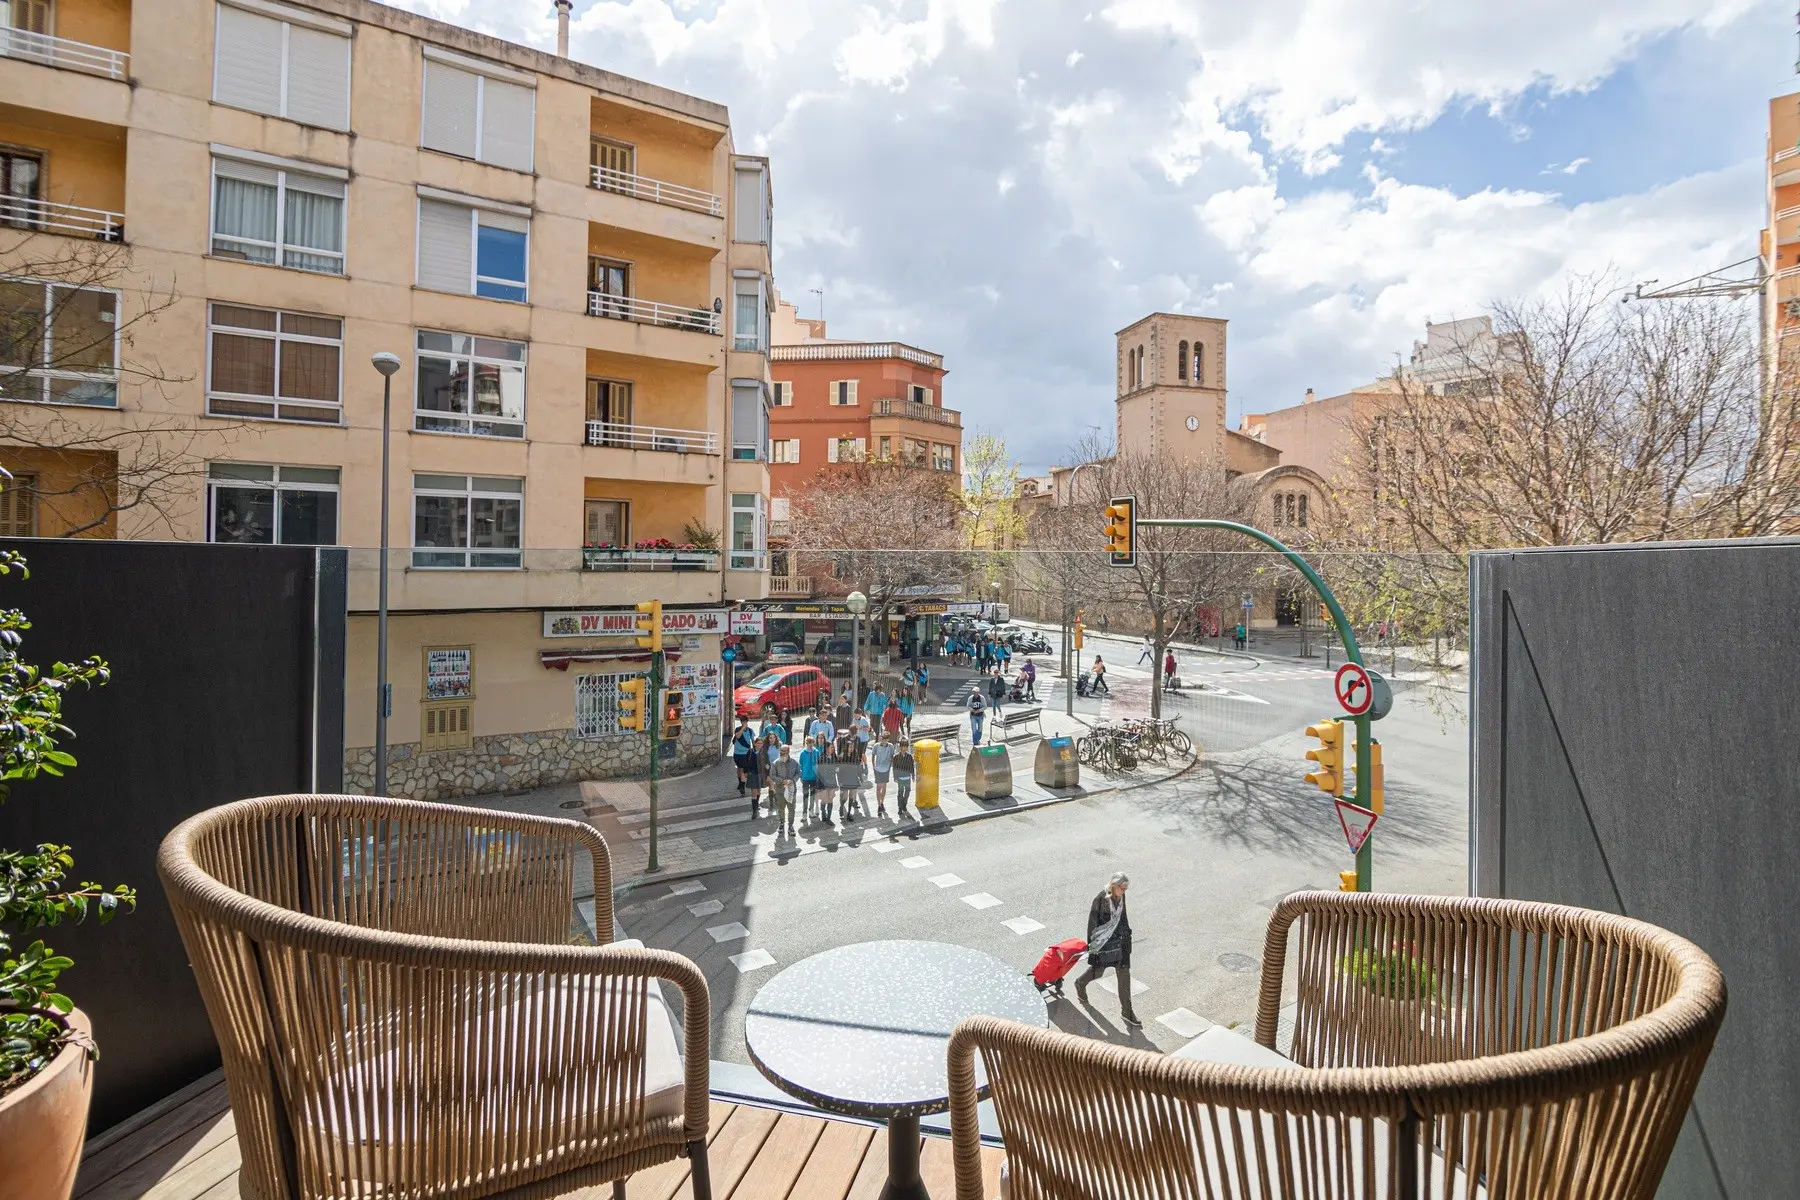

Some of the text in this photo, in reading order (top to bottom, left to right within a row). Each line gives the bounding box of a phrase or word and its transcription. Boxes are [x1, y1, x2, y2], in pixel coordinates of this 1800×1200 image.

[581, 614, 697, 630] DV MINI CADO
